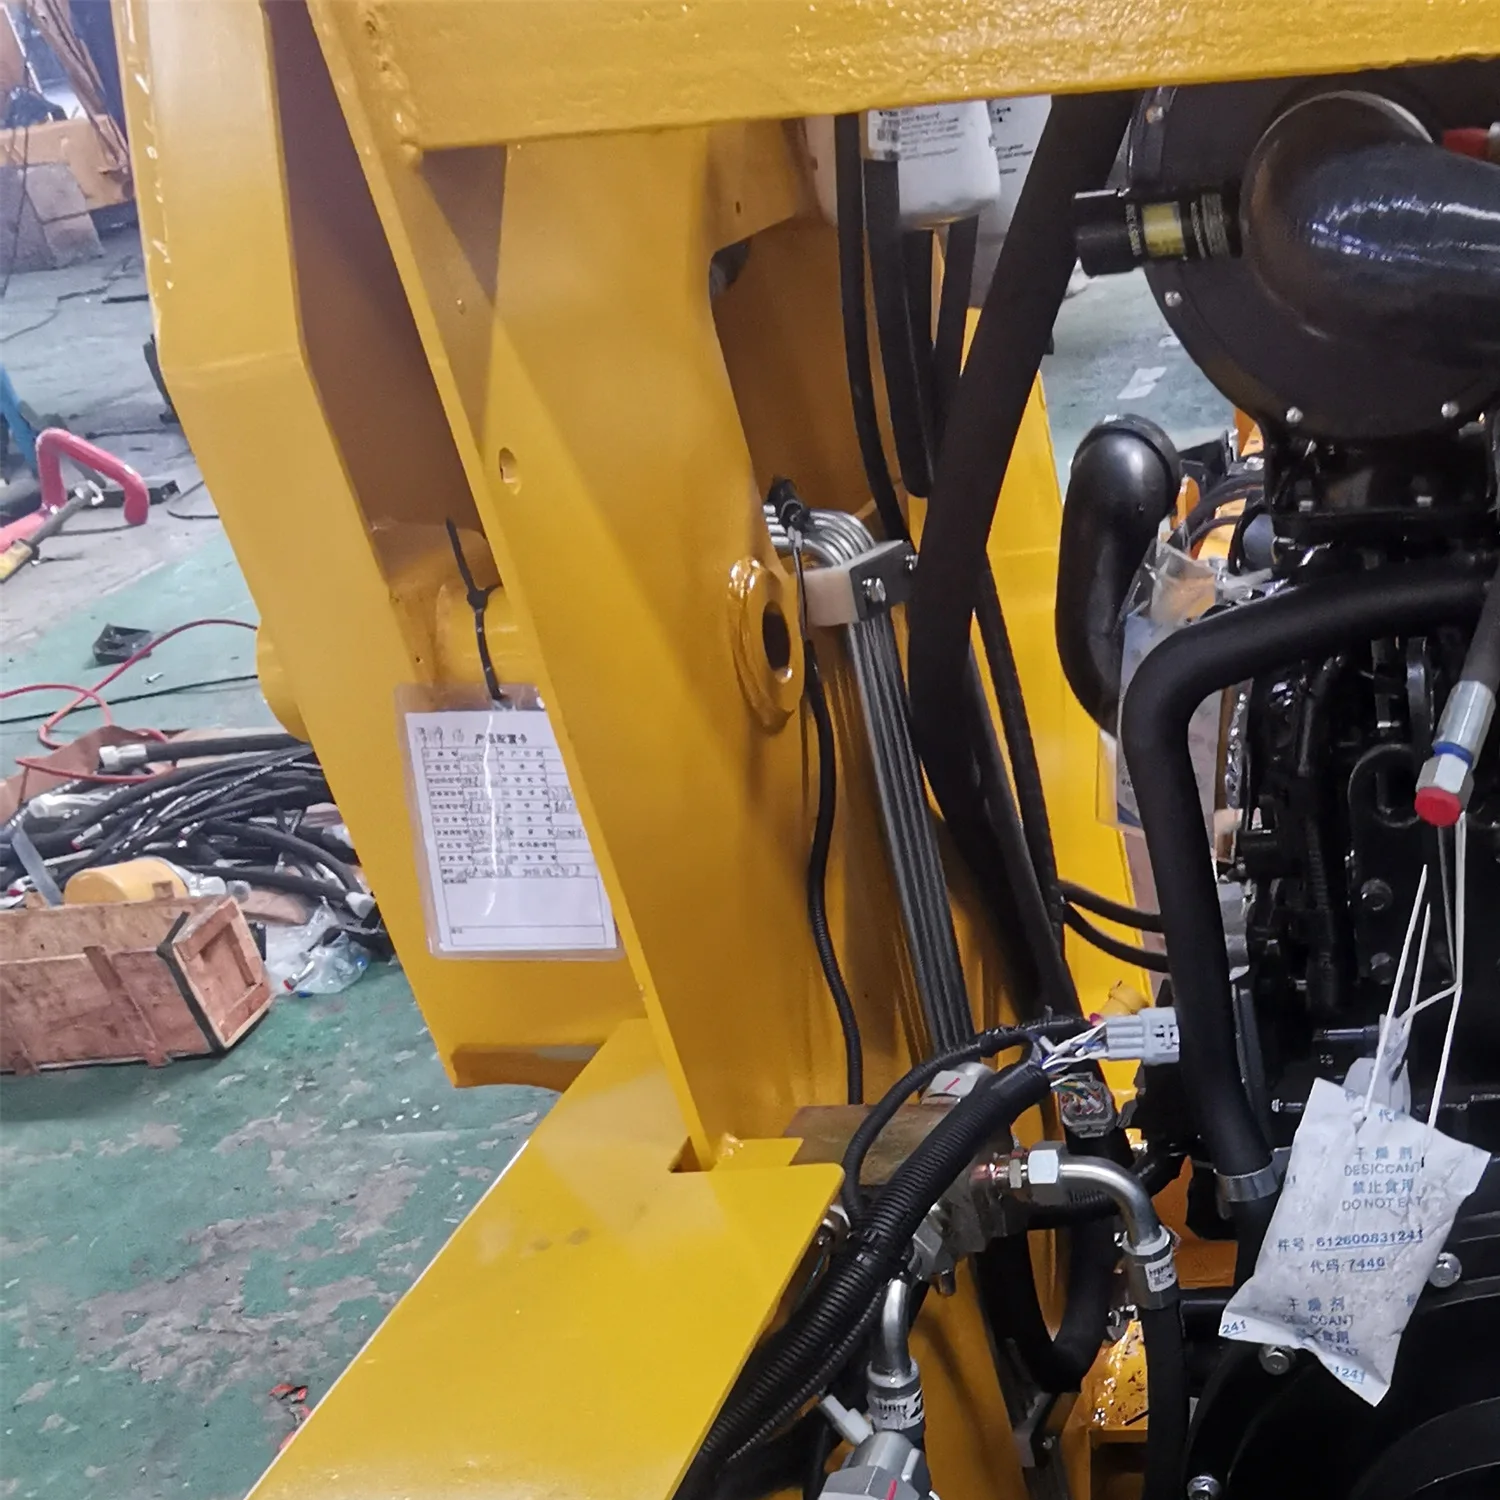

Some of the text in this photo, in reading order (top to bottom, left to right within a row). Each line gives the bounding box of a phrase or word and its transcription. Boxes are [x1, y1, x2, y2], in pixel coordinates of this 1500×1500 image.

[1344, 1162, 1422, 1177] DESICCANT
[1342, 1195, 1422, 1212] DO NOT EAT
